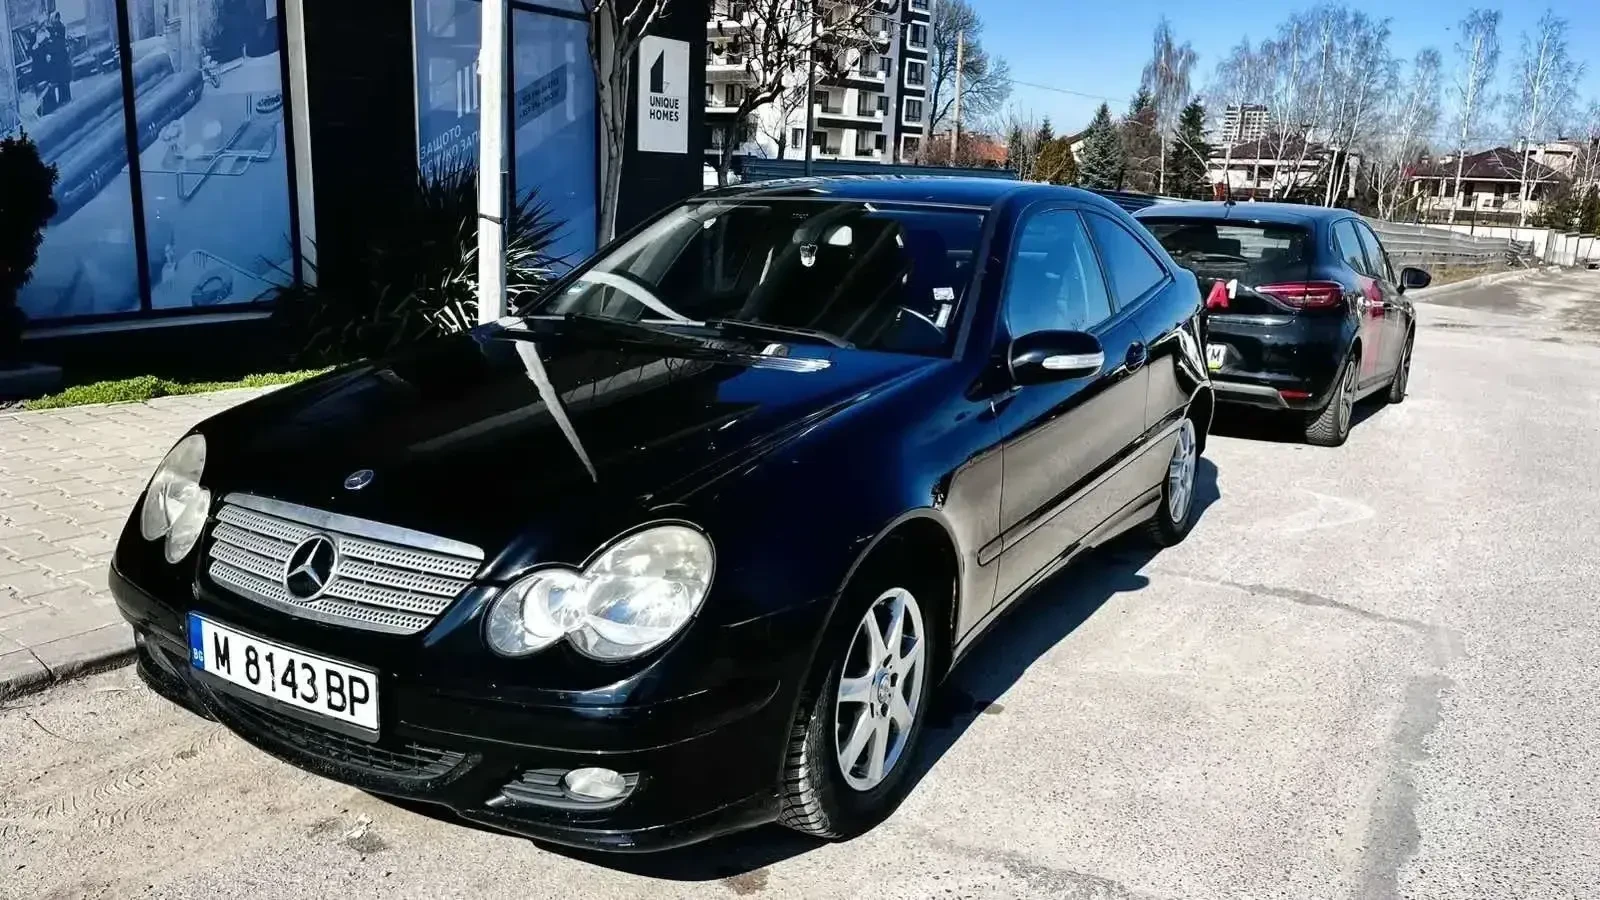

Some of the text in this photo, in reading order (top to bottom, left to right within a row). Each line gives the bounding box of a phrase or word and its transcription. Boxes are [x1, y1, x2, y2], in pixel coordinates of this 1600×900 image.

[649, 96, 680, 110] UNIQUE
[649, 109, 680, 122] HOMES
[420, 124, 461, 160] ЗАЩОТО
[460, 131, 481, 152] ЗАП
[1206, 279, 1238, 309] A1
[193, 647, 205, 662] BG
[213, 631, 370, 717] M 8143 BP
